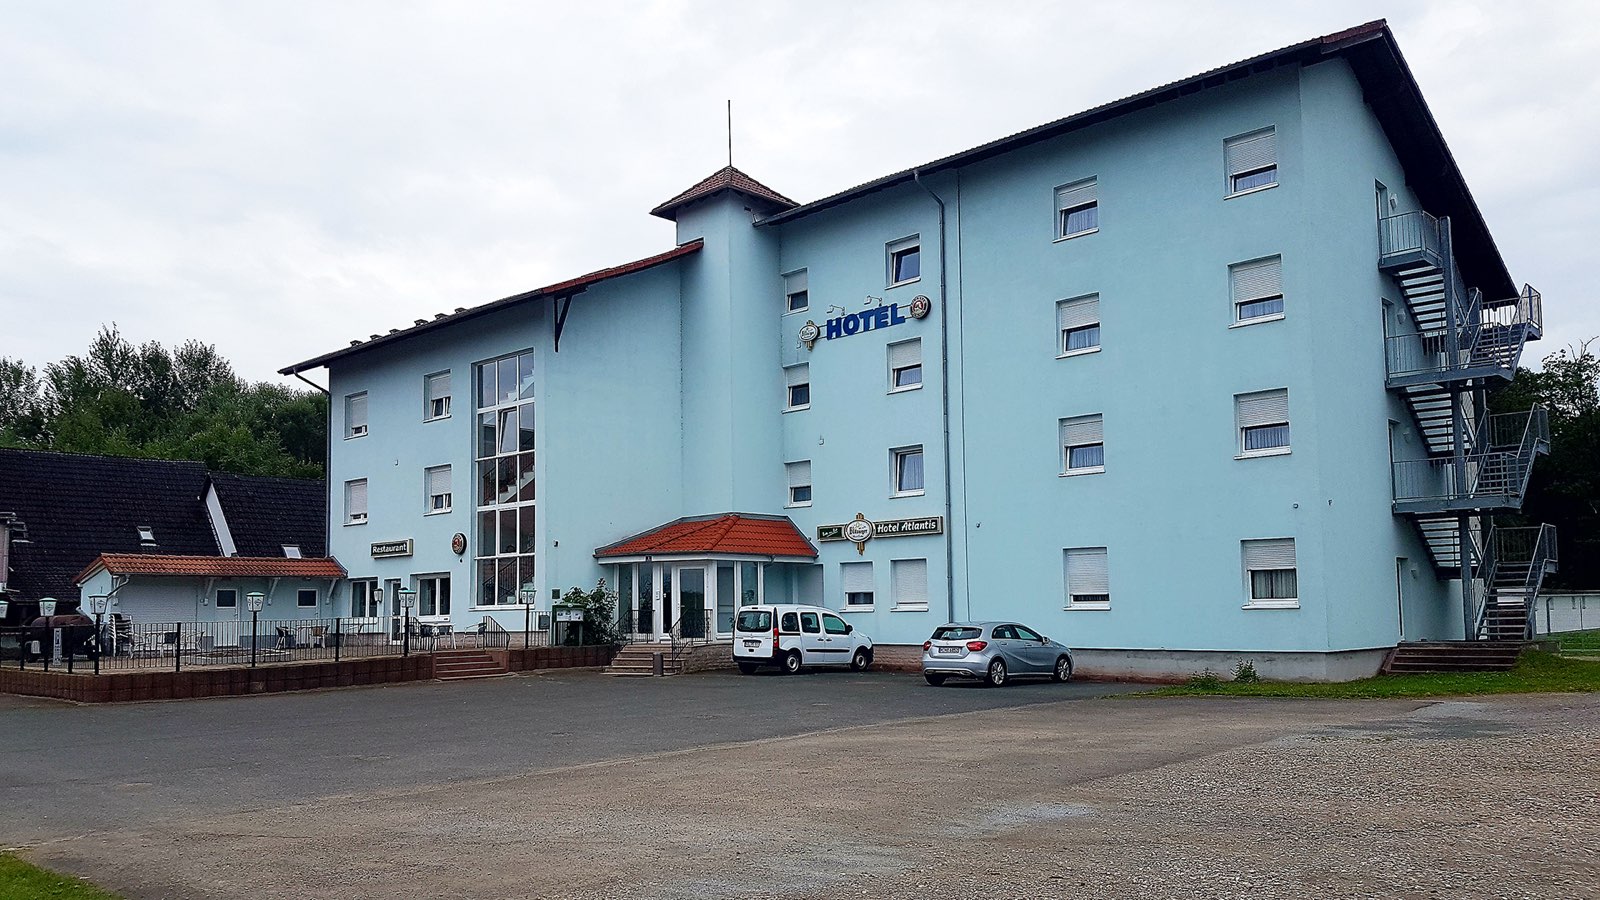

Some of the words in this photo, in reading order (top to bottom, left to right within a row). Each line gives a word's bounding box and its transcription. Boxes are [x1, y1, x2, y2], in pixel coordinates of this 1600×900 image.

[826, 303, 906, 340] HOTEL
[877, 523, 899, 533] Hotel
[901, 520, 936, 531] Atlantis
[372, 543, 407, 554] Restaurant
